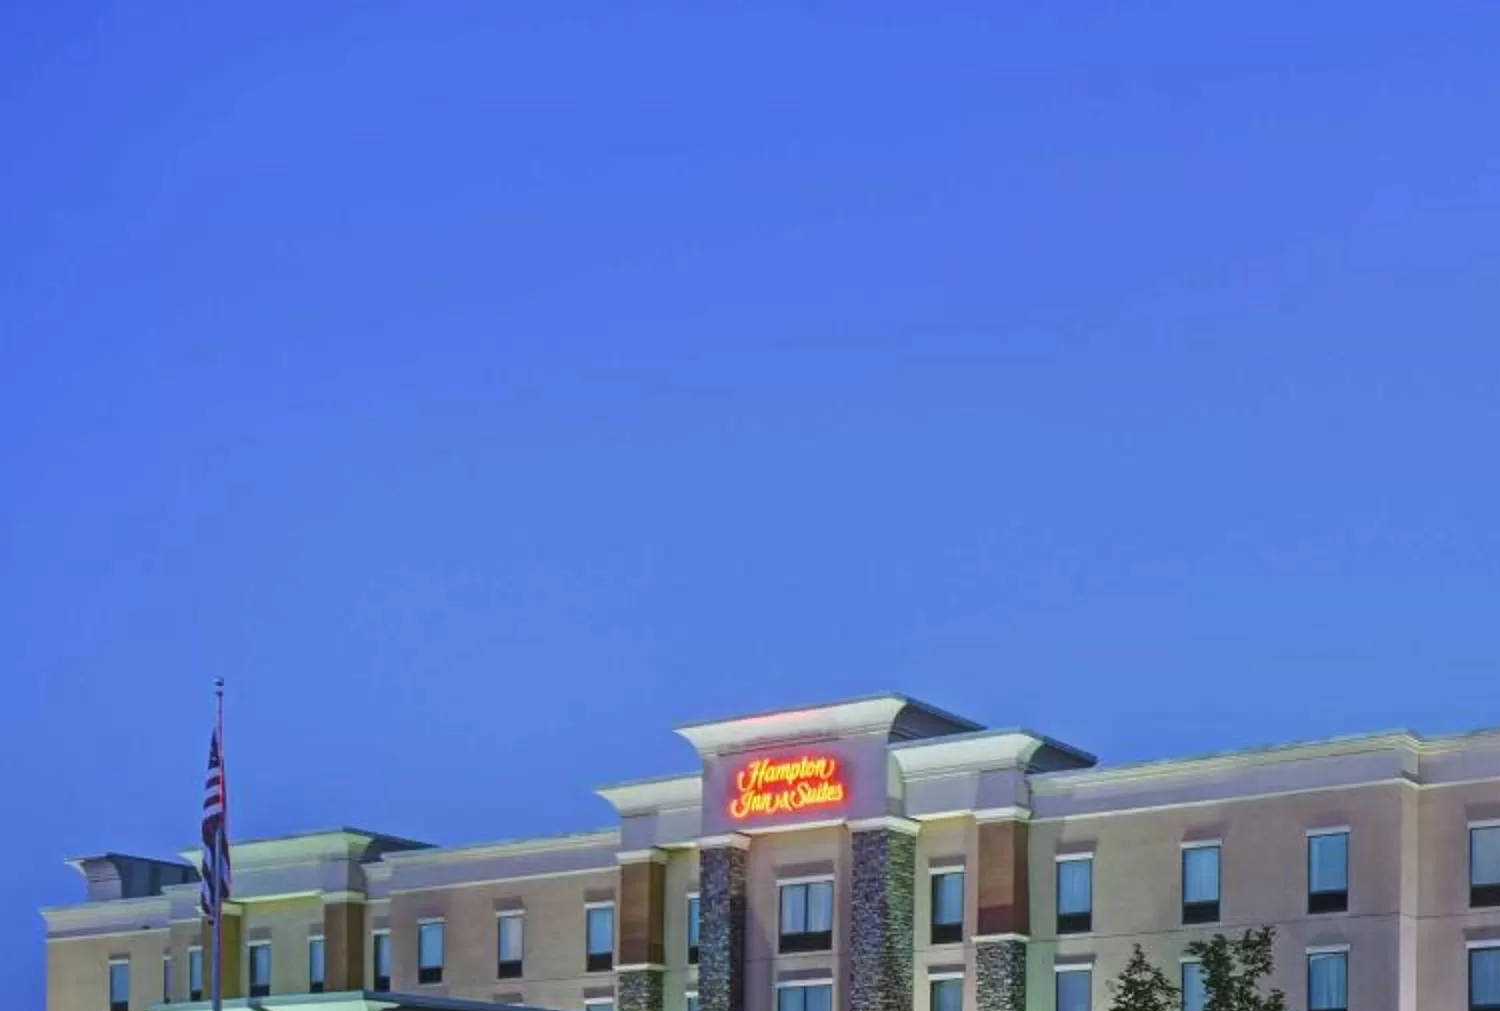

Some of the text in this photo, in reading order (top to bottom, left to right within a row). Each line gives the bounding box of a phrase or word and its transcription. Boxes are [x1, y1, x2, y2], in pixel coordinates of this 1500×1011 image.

[737, 756, 835, 792] Hampton
[731, 790, 777, 818] Inn
[792, 782, 843, 808] Suites
